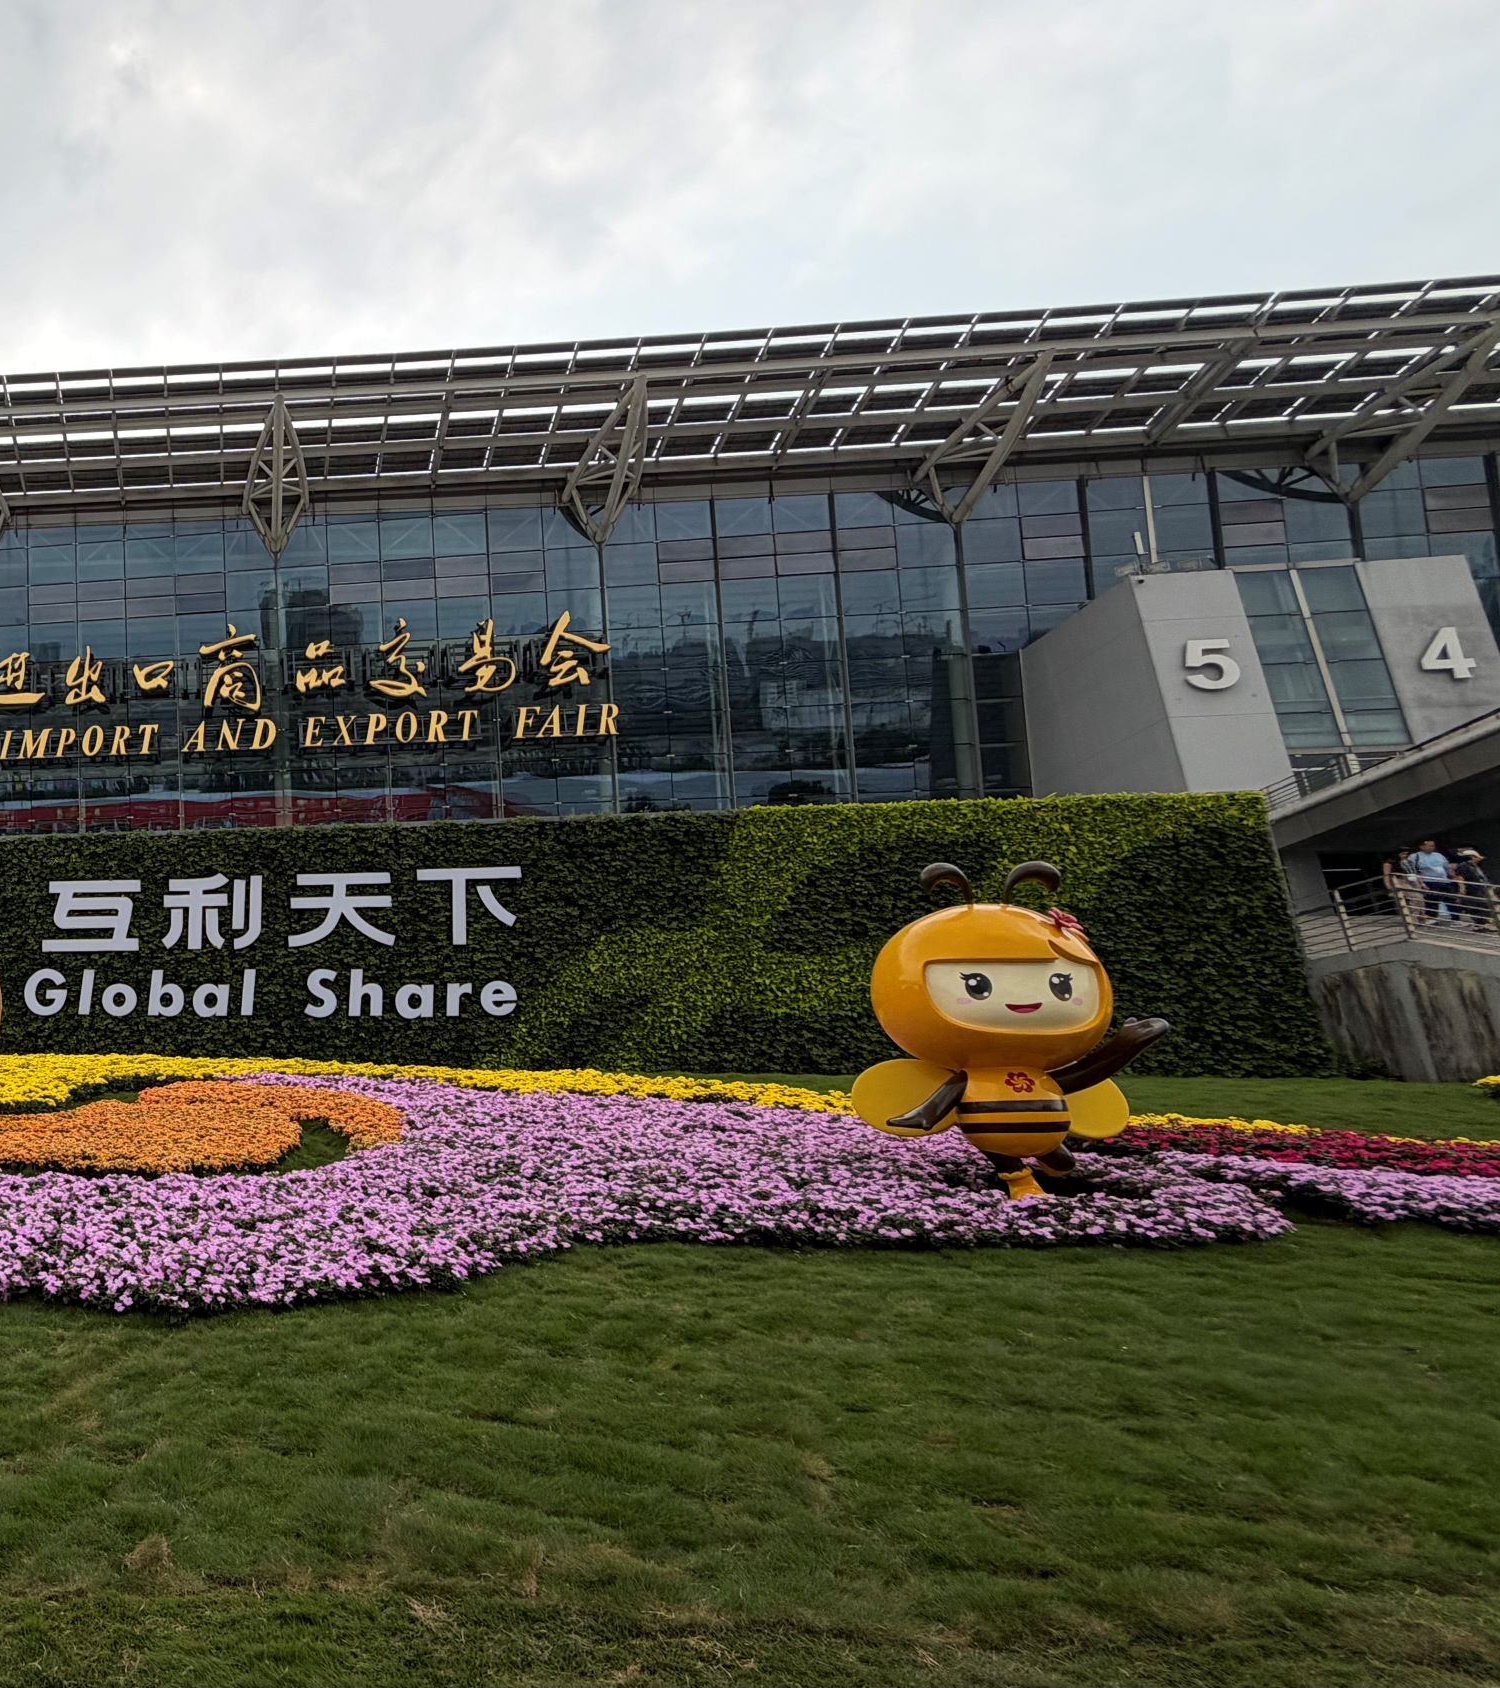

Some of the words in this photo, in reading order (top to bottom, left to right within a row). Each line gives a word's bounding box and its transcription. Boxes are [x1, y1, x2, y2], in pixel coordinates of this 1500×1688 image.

[1184, 638, 1241, 691] 5
[1421, 626, 1477, 679] 4
[0, 723, 160, 761] IMPORT
[181, 717, 277, 753] AND
[304, 709, 480, 747] EXPORT
[513, 703, 620, 739] FAIR
[41, 865, 523, 953] 互利天下
[23, 967, 257, 1018] Global
[303, 967, 519, 1020] Share
